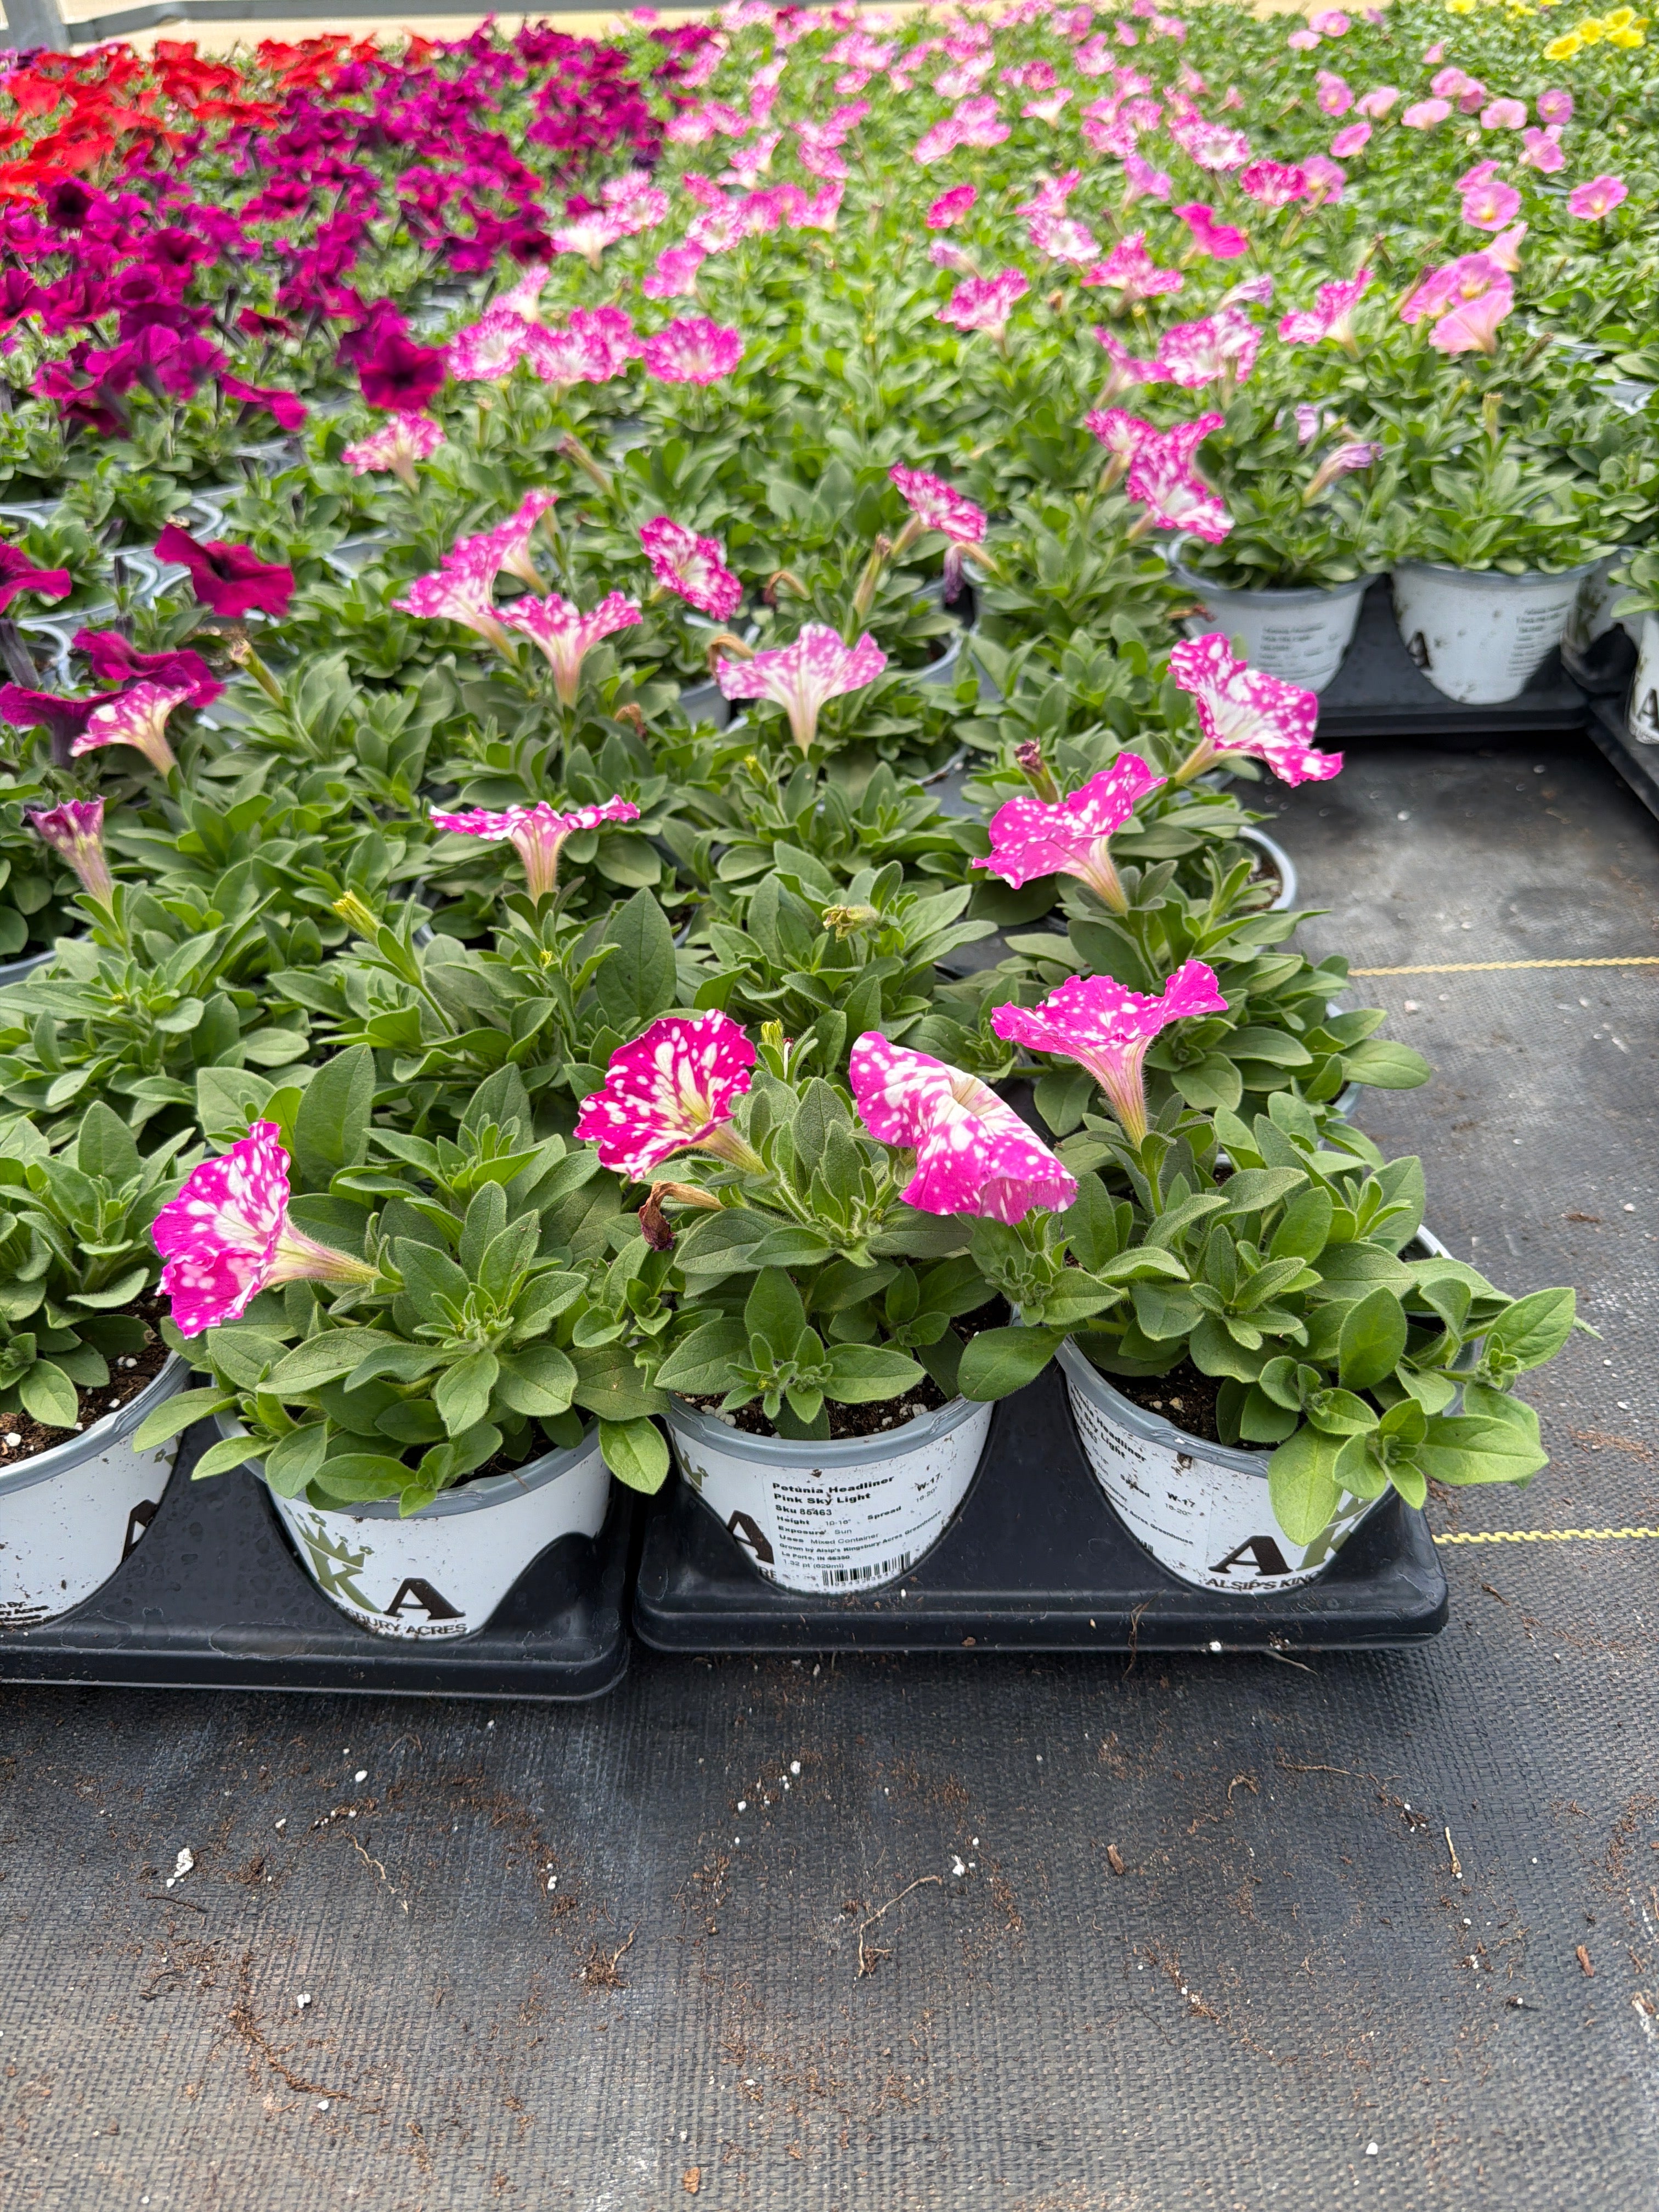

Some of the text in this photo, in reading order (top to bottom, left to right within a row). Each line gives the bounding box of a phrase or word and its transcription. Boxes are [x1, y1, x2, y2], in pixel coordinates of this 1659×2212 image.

[1097, 1416, 1147, 1462] Headliner
[1101, 1432, 1126, 1459] Light
[772, 1476, 895, 1493] Petunia Headliner
[774, 1493, 803, 1504] Pink
[837, 1493, 871, 1503] Light
[1165, 1491, 1195, 1508] W-17
[775, 1504, 797, 1514] Sku
[777, 1515, 810, 1525] Height
[867, 1505, 901, 1520] Spread
[778, 1525, 825, 1535] Exposure
[780, 1543, 803, 1551] Grown
[843, 1541, 882, 1552] Kingsbury
[882, 1533, 902, 1544] Acres
[905, 1510, 942, 1535] Greenhouse
[780, 1534, 804, 1543] Uses
[838, 1533, 879, 1544] Container
[793, 1553, 815, 1561] Porte,
[1205, 1577, 1277, 1591] ALSIP'S
[382, 1578, 466, 1620] A
[405, 1623, 468, 1636] ACRES
